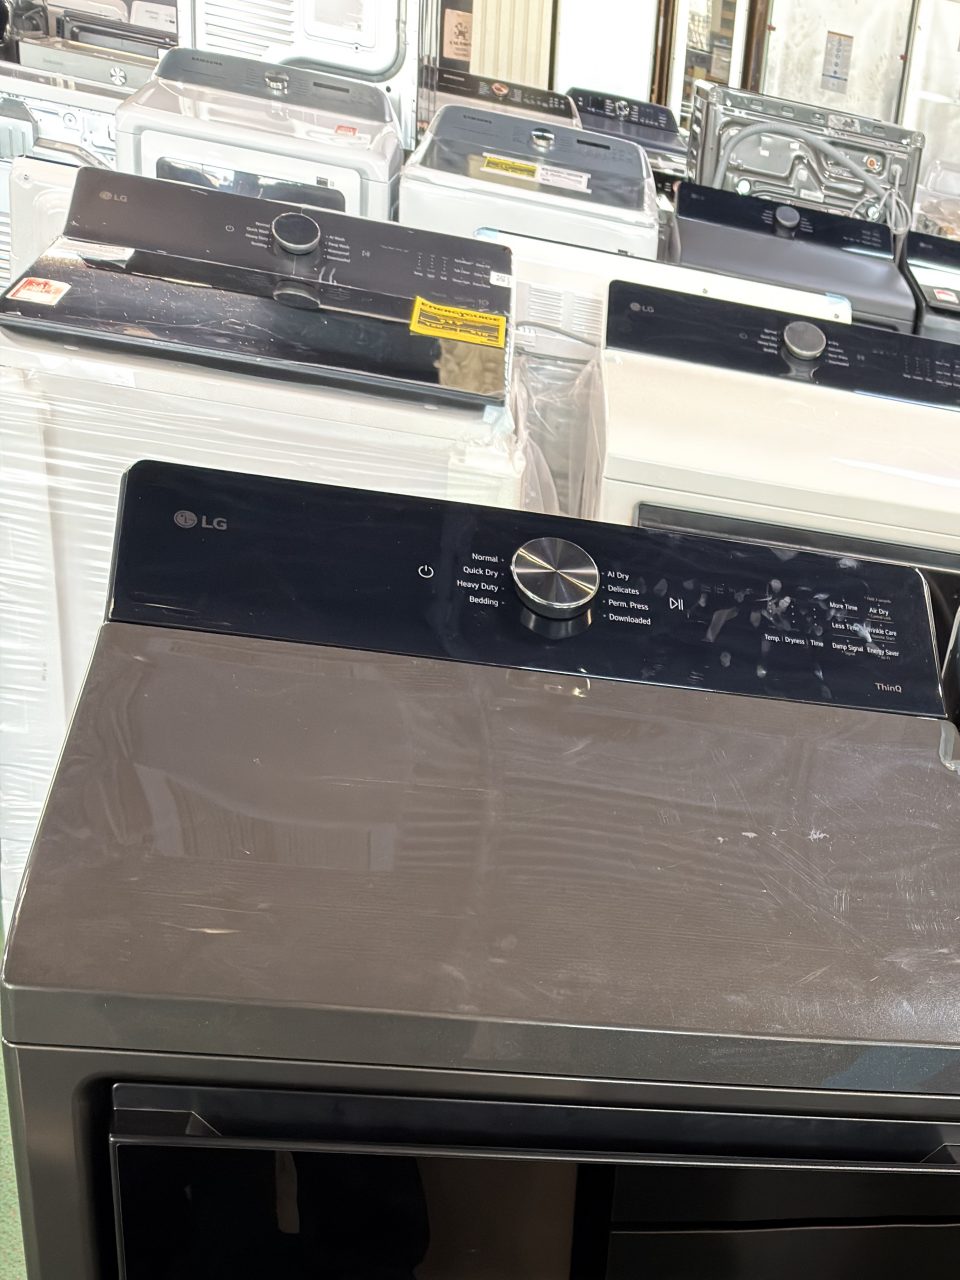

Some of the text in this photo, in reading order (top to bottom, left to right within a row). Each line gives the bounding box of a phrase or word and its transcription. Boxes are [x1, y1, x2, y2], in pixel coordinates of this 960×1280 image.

[472, 552, 498, 563] Normal
[463, 565, 499, 578] Quick Dry
[607, 570, 630, 581] AI Dry
[456, 579, 499, 592] Heavy Duty
[607, 584, 640, 596] Delicates
[469, 595, 499, 607] Bedding
[608, 598, 649, 611] Perm. Press
[829, 601, 858, 611] More Time
[878, 608, 889, 616] Dry
[608, 613, 651, 626] Downloaded
[885, 629, 897, 637] Care
[764, 633, 824, 647] Temp. Dryness Time
[831, 642, 864, 653] Damp Signal
[866, 646, 899, 657] Energy Saver
[874, 682, 902, 693] ThinQ
